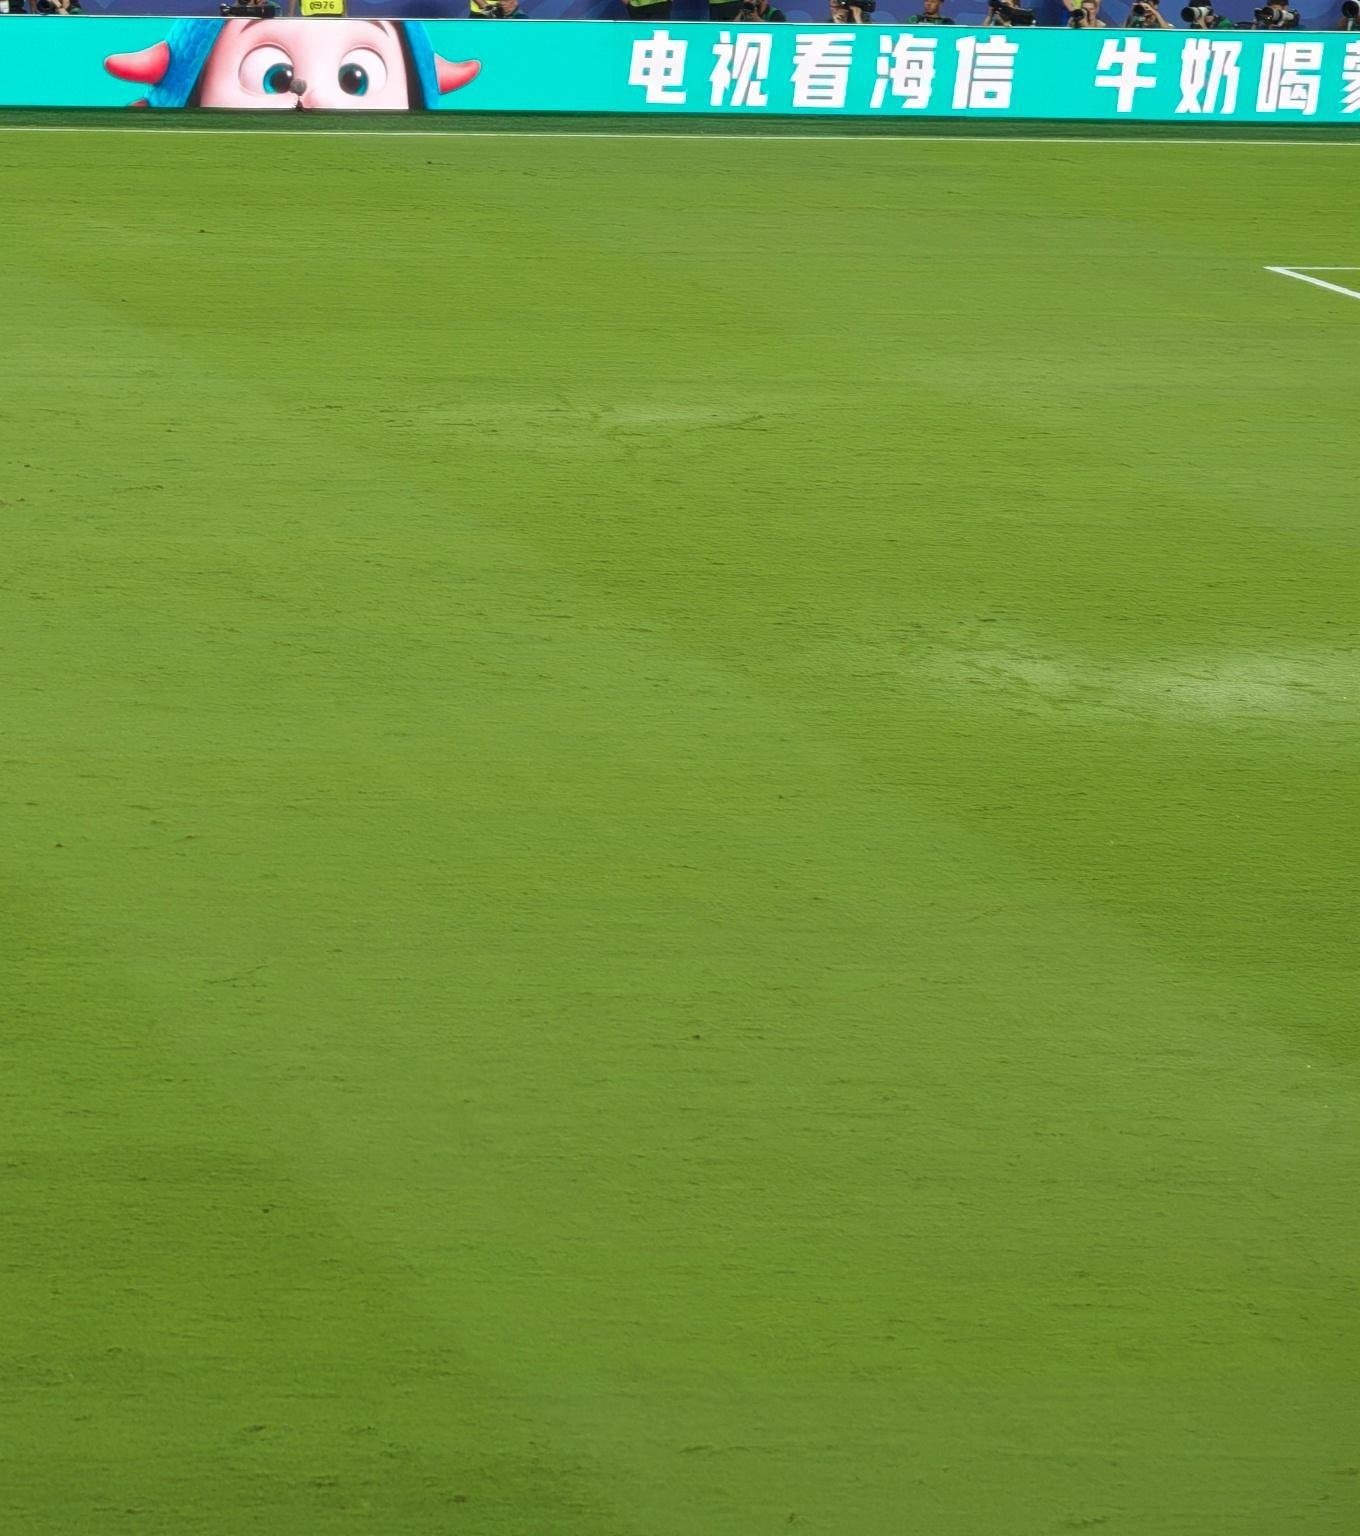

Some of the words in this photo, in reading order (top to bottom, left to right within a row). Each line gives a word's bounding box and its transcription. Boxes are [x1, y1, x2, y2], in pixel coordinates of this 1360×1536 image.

[630, 31, 1017, 108] 电视看海信
